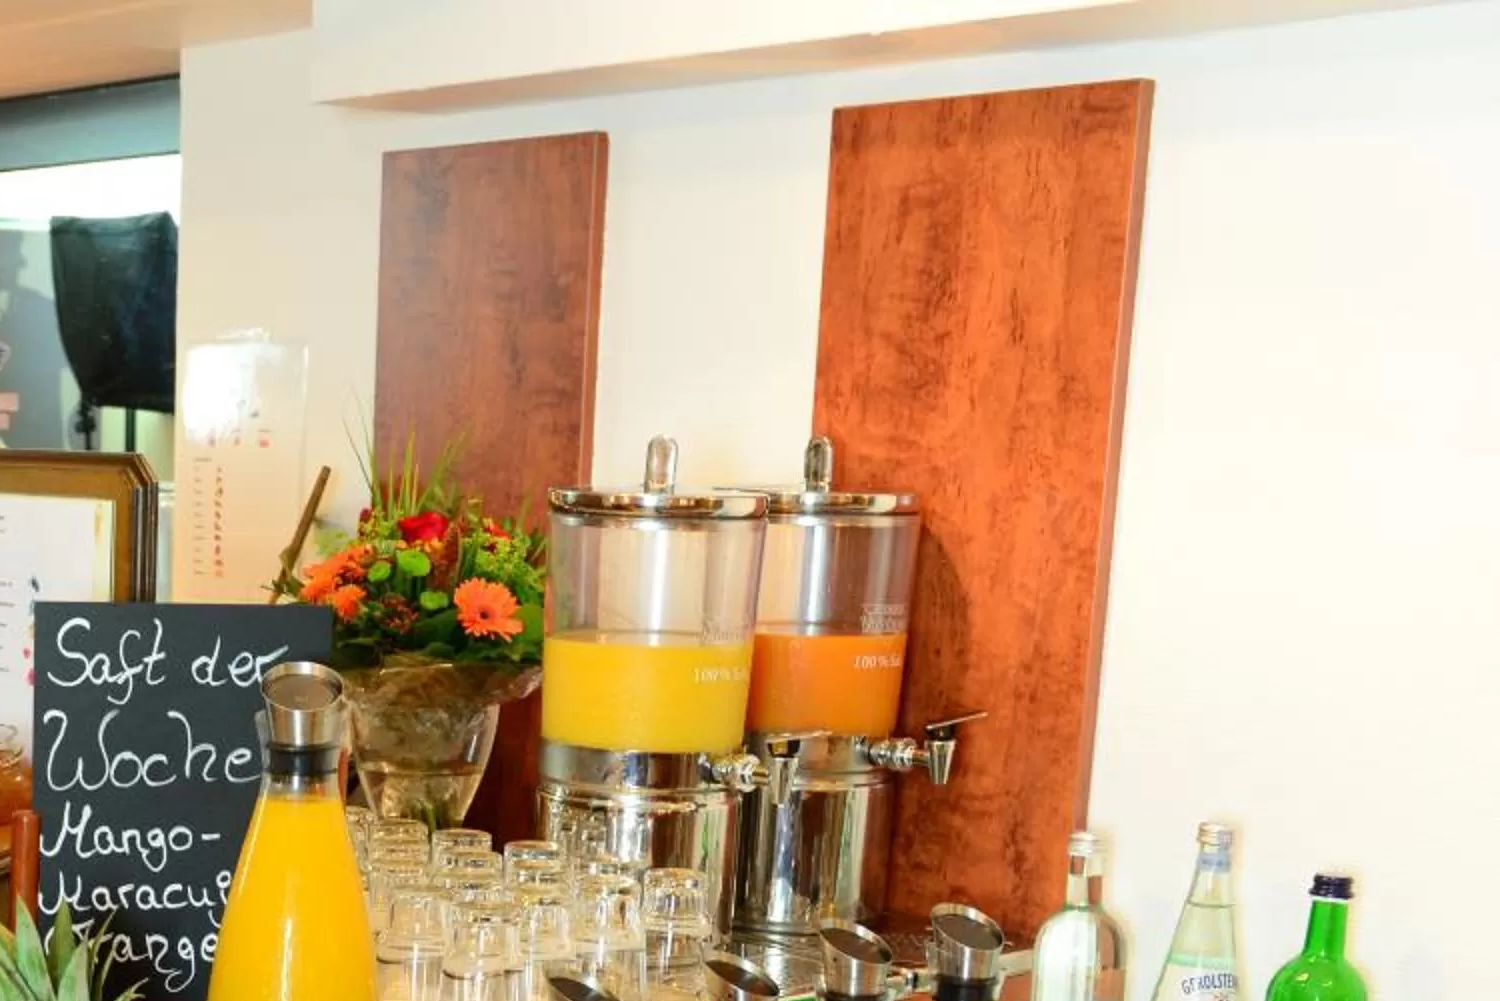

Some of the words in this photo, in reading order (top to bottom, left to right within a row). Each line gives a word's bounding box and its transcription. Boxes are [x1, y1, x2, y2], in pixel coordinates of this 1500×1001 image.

[47, 617, 166, 704] Saft
[191, 634, 289, 687] der
[43, 708, 262, 791] Woche
[39, 800, 221, 873] Mango-
